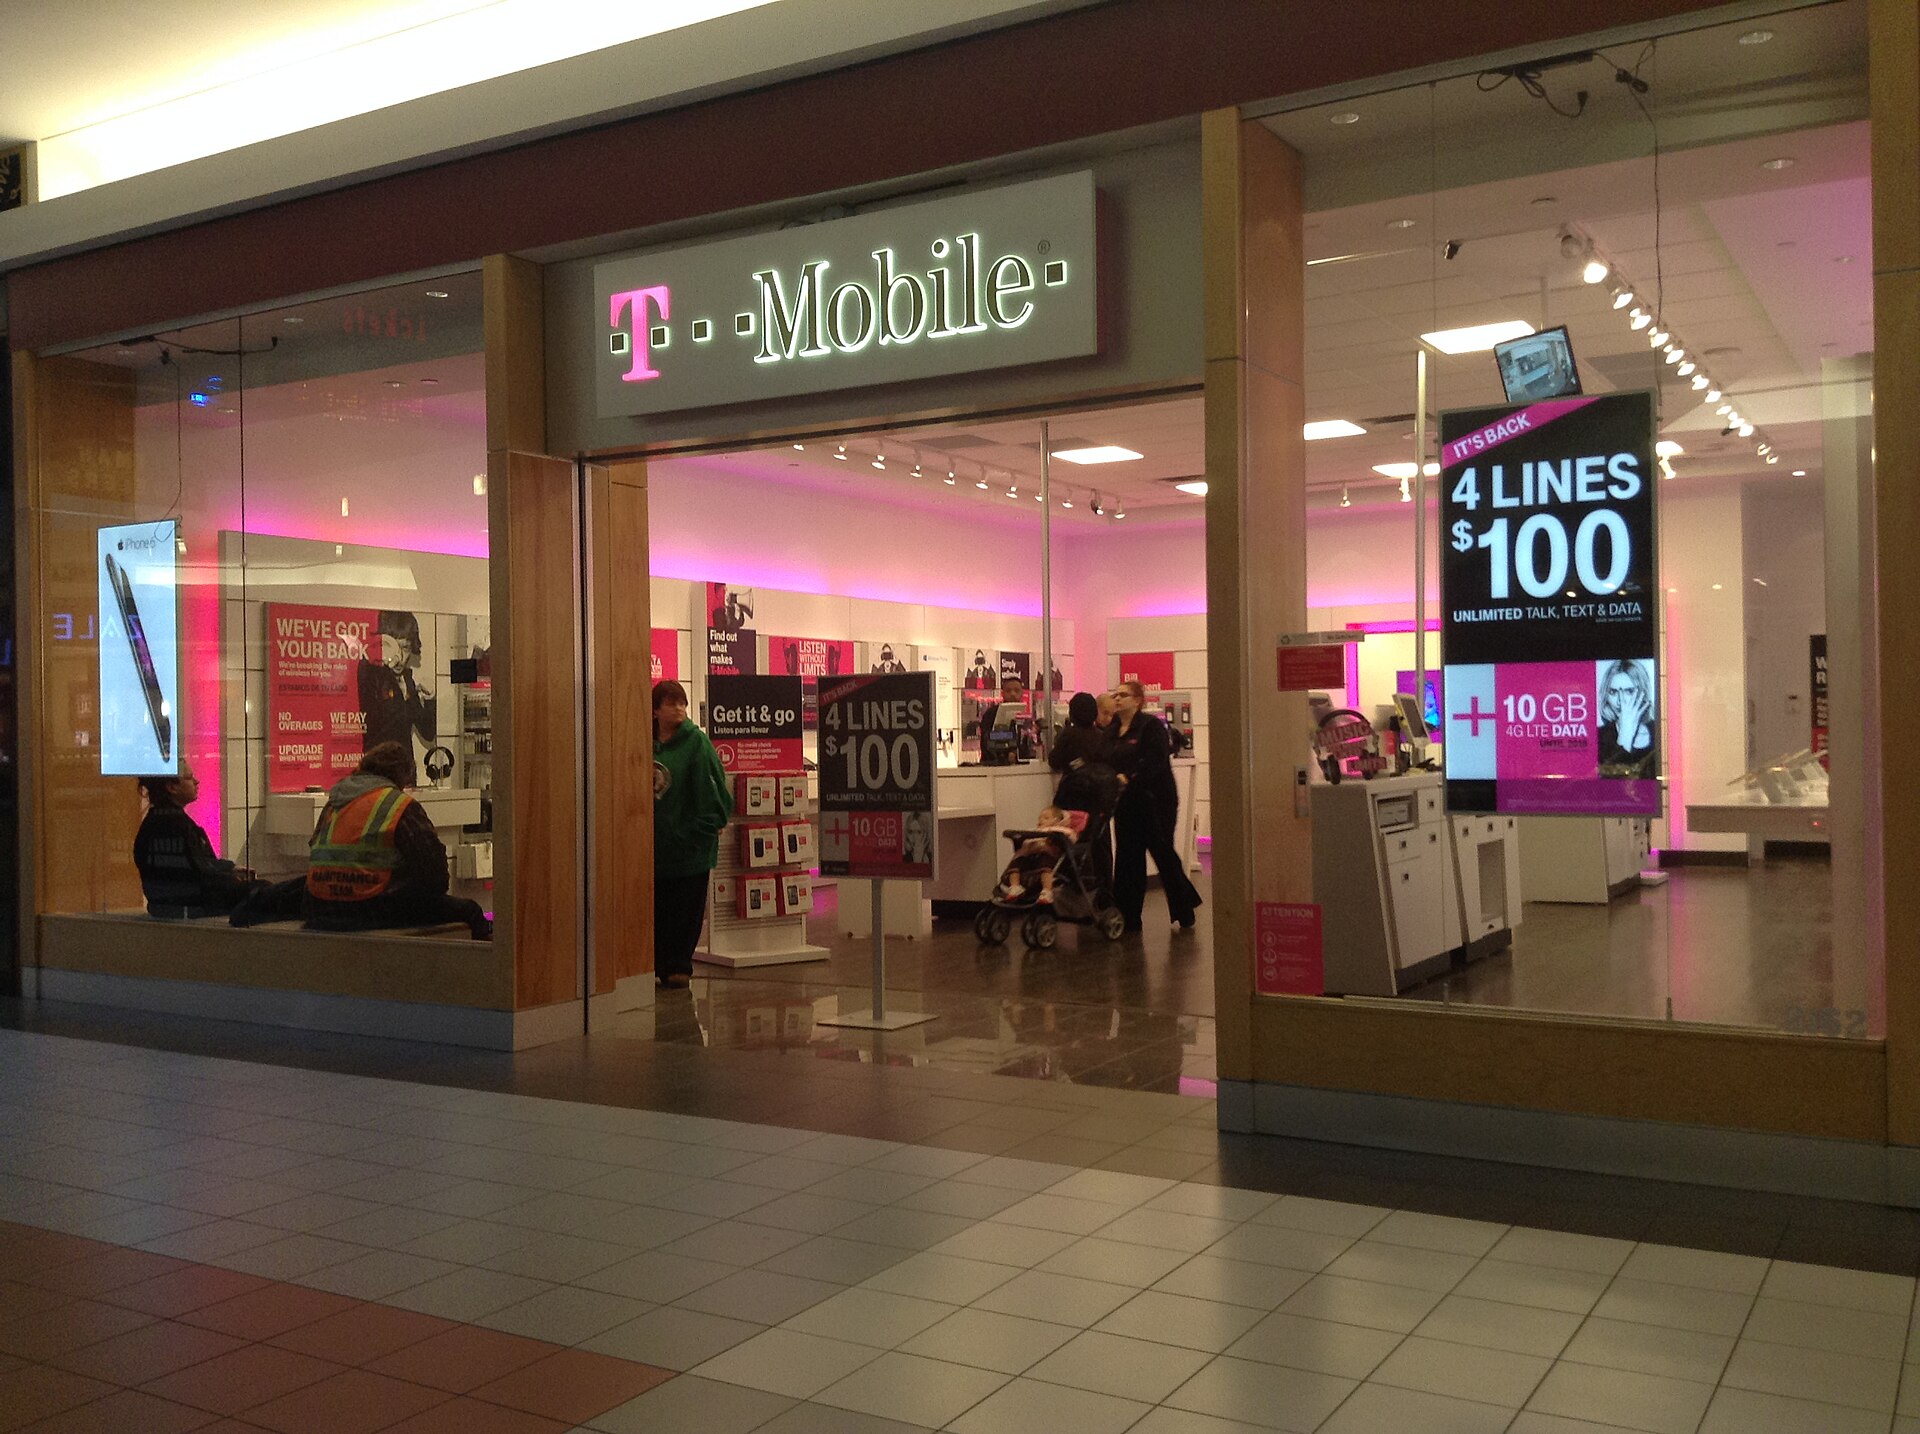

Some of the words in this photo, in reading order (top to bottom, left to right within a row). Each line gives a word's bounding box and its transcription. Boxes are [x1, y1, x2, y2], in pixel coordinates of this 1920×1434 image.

[1453, 436, 1485, 459] IT'S
[1484, 412, 1531, 445] BACK
[1451, 466, 1481, 511] 4
[1491, 452, 1642, 509] LINES
[1451, 508, 1632, 599] $100
[1453, 607, 1523, 623] UNLIMITED
[1526, 605, 1560, 620] TALK,
[1562, 604, 1595, 618] TEXT
[1597, 604, 1606, 616] &
[1609, 601, 1642, 616] DATA
[276, 618, 332, 639] WE'VE
[335, 621, 370, 641] GOT
[709, 629, 726, 641] Find
[726, 632, 738, 642] out
[276, 640, 324, 659] YOUR
[327, 642, 370, 661] BACK
[709, 643, 728, 653] what
[799, 640, 827, 654] LISTEN
[710, 654, 733, 665] makes
[799, 653, 826, 664] WITHOUT
[799, 663, 827, 676] LIMITS
[838, 680, 858, 699] BACK
[824, 701, 841, 731] 4
[847, 699, 925, 731] LINES
[1503, 694, 1537, 724] 10
[1542, 693, 1588, 723] GB
[278, 711, 292, 721] NO
[330, 711, 346, 724] WE
[347, 711, 368, 724] PAY
[713, 704, 743, 724] Get
[745, 705, 757, 723] it
[759, 704, 772, 724] &
[774, 710, 796, 727] go
[278, 720, 324, 732] OVERAGES
[713, 726, 735, 735] Listos
[734, 727, 751, 736] para
[1505, 724, 1524, 738] 4G
[1526, 724, 1549, 738] LTE
[1552, 723, 1588, 738] DATA
[278, 743, 324, 755] UPGRADE
[331, 753, 343, 763] NO
[824, 733, 920, 791] $100
[825, 793, 865, 802] UNLIMITED
[908, 792, 926, 802] DATA
[852, 817, 871, 837] 10
[872, 817, 897, 838] GB
[878, 838, 897, 847] DATA
[1261, 907, 1314, 919] ATTENTION
